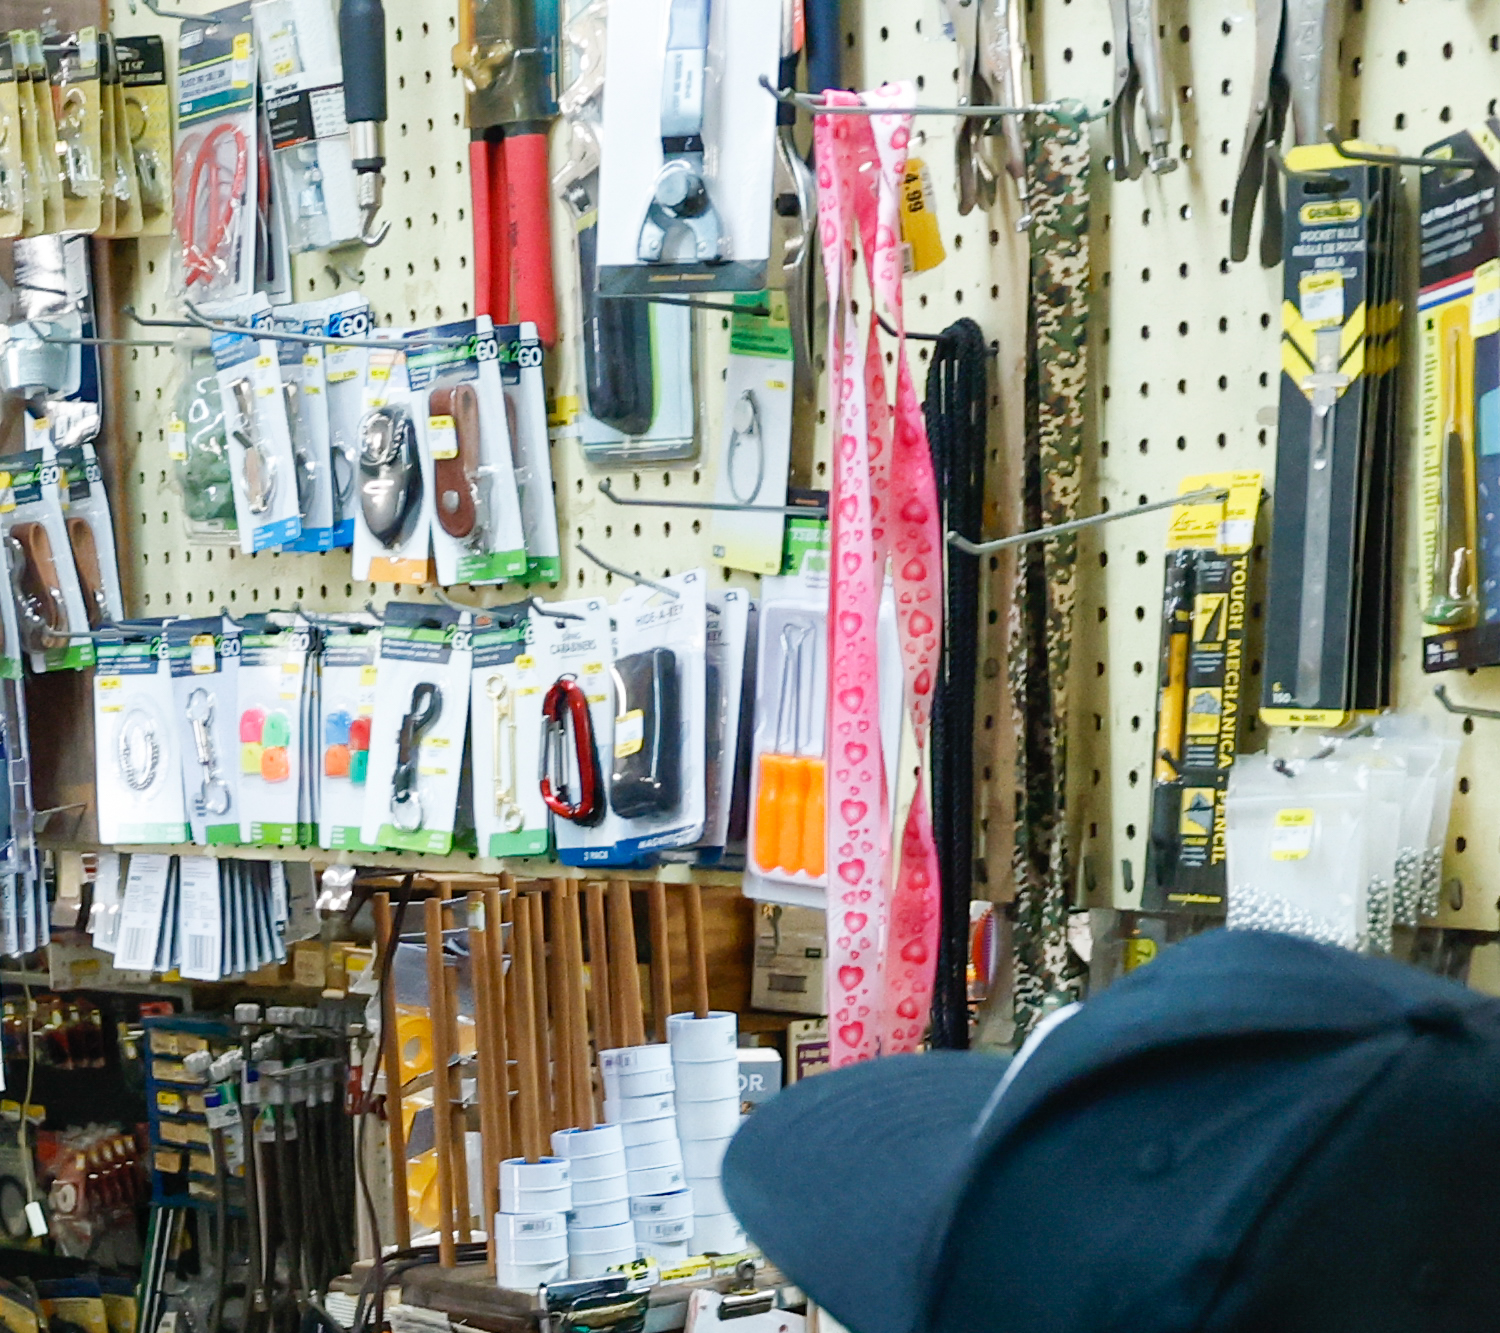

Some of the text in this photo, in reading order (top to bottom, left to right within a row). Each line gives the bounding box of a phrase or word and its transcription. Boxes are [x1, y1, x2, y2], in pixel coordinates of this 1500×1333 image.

[329, 311, 369, 337] 2GO
[468, 335, 498, 361] 2GO
[508, 340, 543, 367] 2GO
[1211, 556, 1249, 865] TOUGH MECHANICA PENCIL
